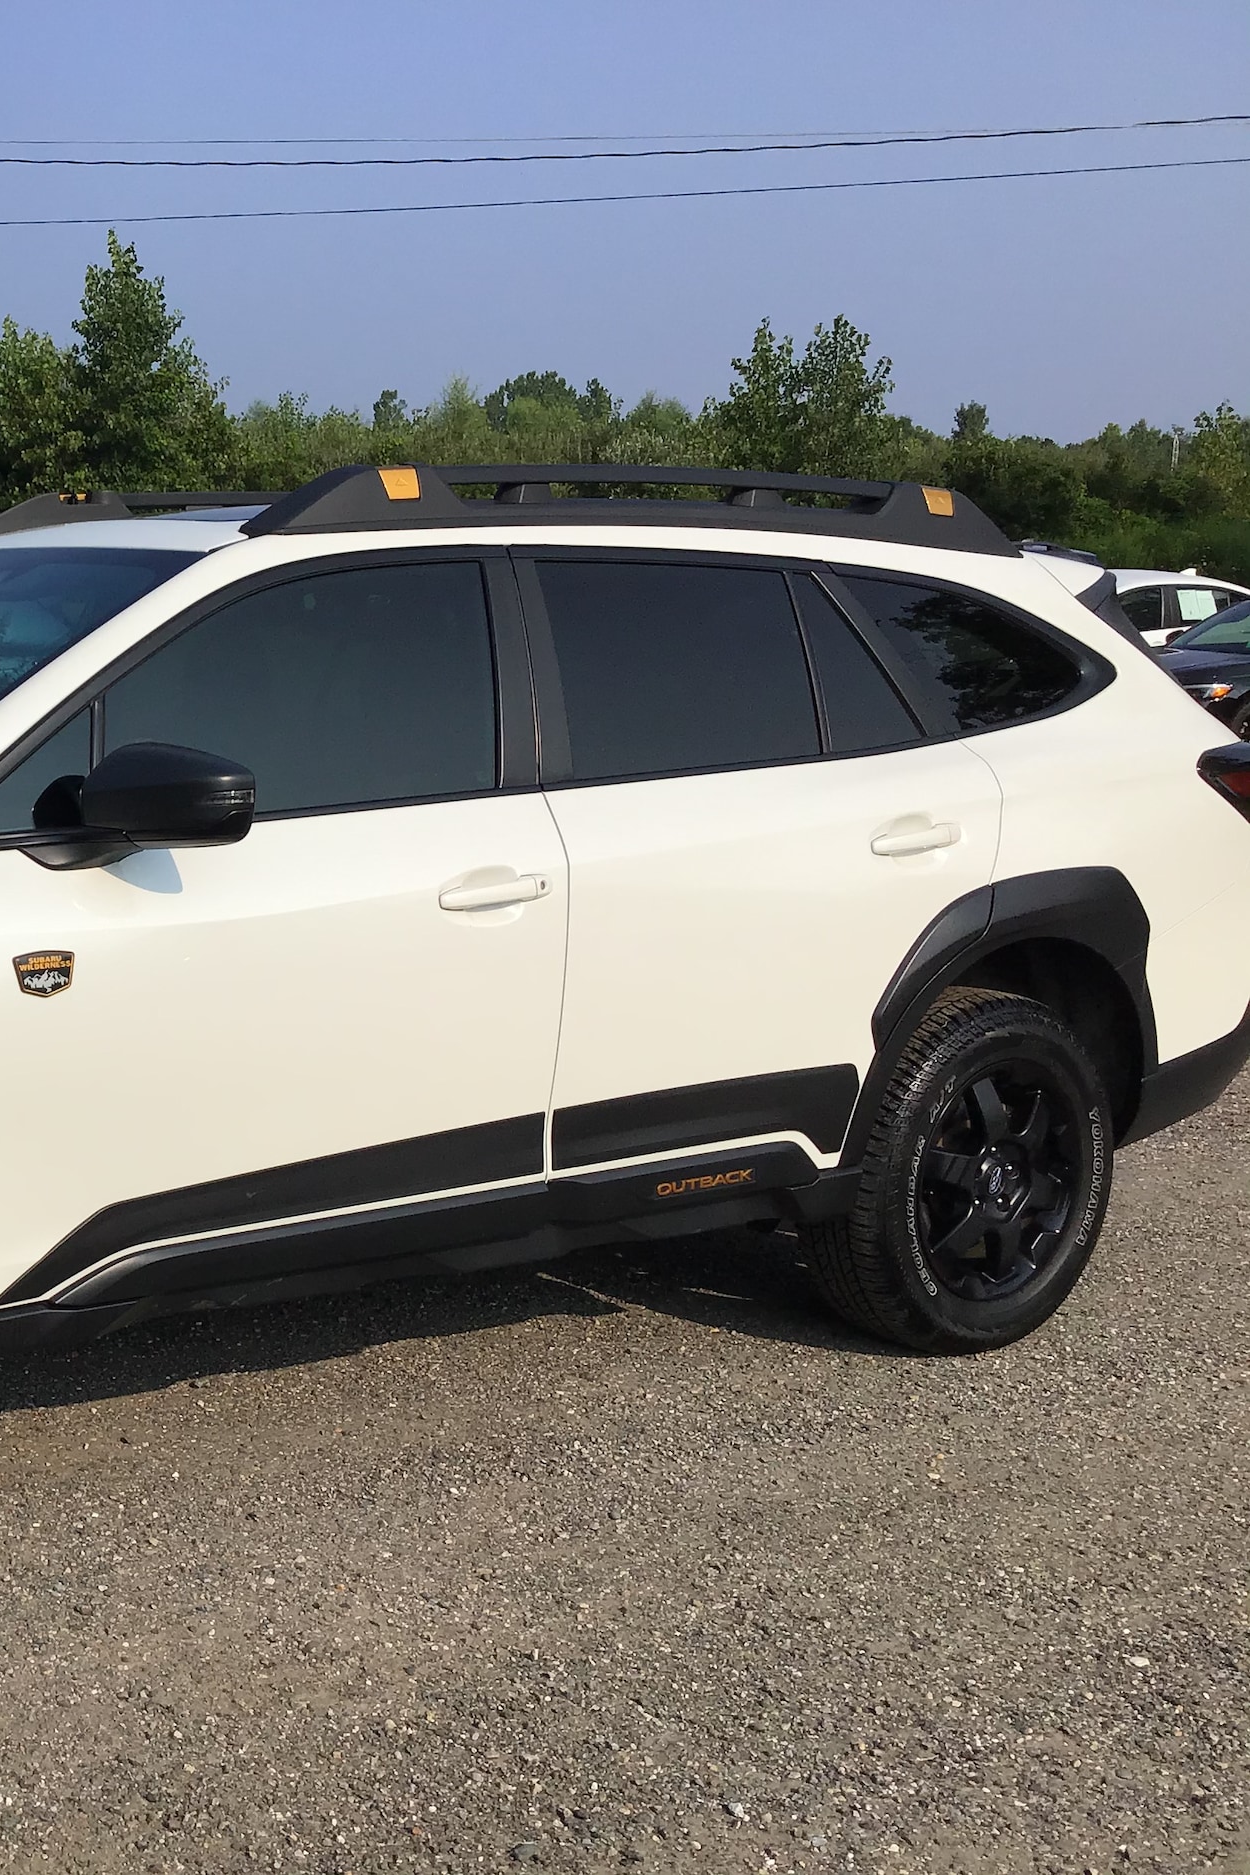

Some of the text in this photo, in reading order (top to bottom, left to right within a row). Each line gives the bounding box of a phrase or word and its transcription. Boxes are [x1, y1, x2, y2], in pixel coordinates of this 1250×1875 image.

[19, 960, 71, 971] WILDERNESS
[28, 955, 62, 965] SUBARU
[656, 1168, 754, 1197] OUTBACK
[1074, 1105, 1105, 1248] YOKOHAMA
